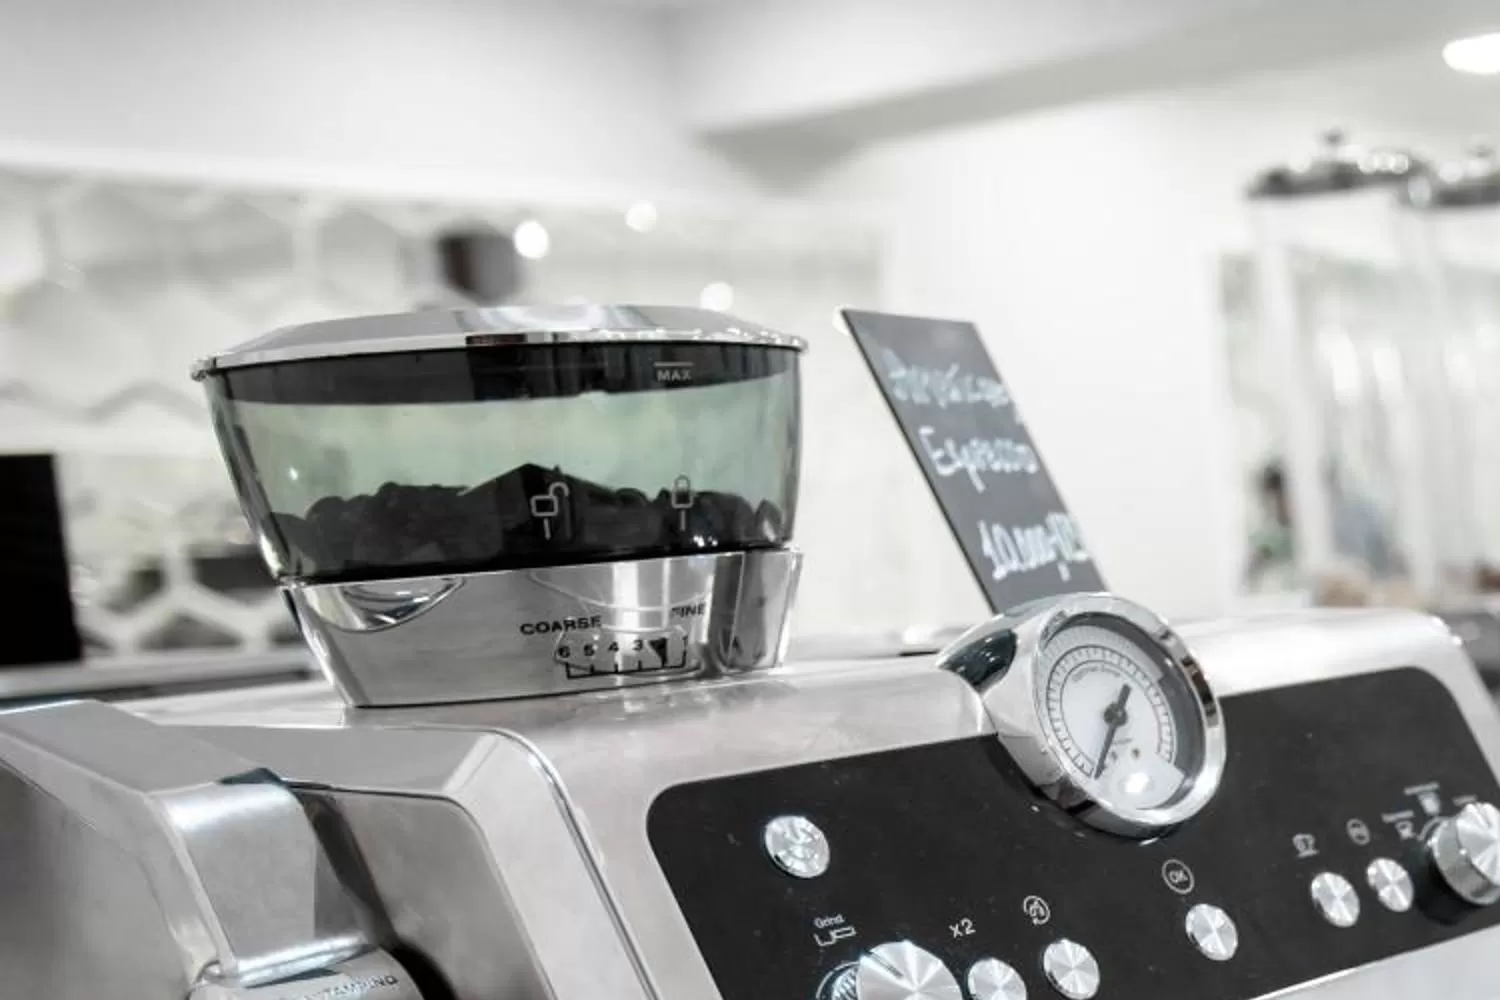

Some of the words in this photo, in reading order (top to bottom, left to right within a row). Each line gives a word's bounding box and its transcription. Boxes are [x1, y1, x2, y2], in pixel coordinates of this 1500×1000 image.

[656, 368, 693, 383] MAX
[519, 614, 602, 636] COARSE
[557, 644, 571, 659] 6
[607, 640, 620, 654] 4
[632, 638, 645, 652] 3
